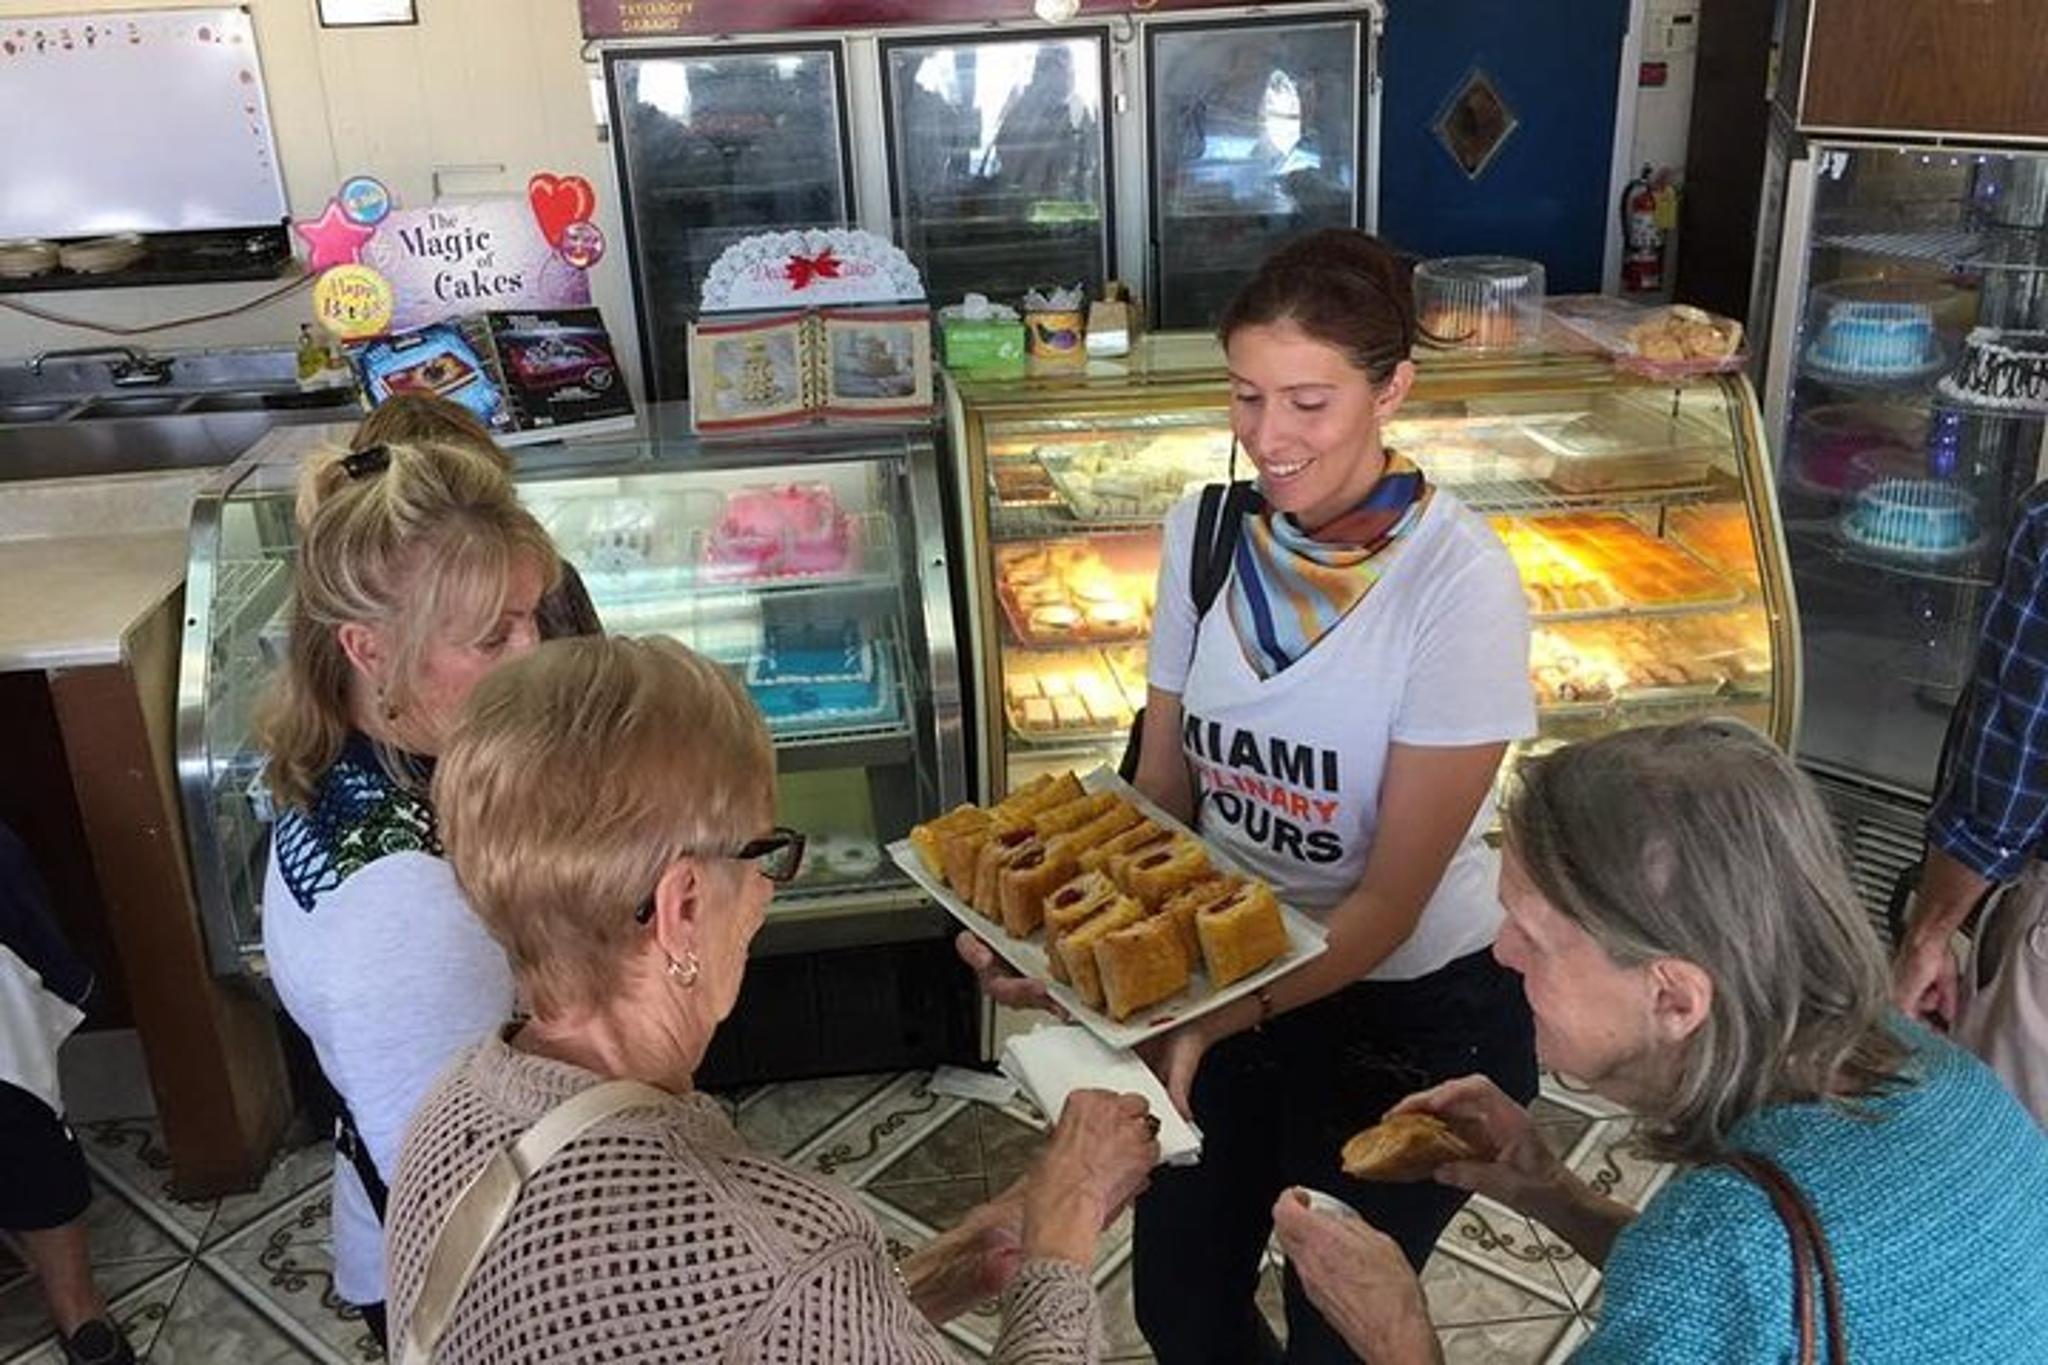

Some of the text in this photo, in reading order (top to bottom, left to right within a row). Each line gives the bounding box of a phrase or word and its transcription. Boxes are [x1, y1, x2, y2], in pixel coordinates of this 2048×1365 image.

[398, 226, 490, 262] Magic
[477, 251, 494, 269] of
[434, 269, 523, 301] Cakes
